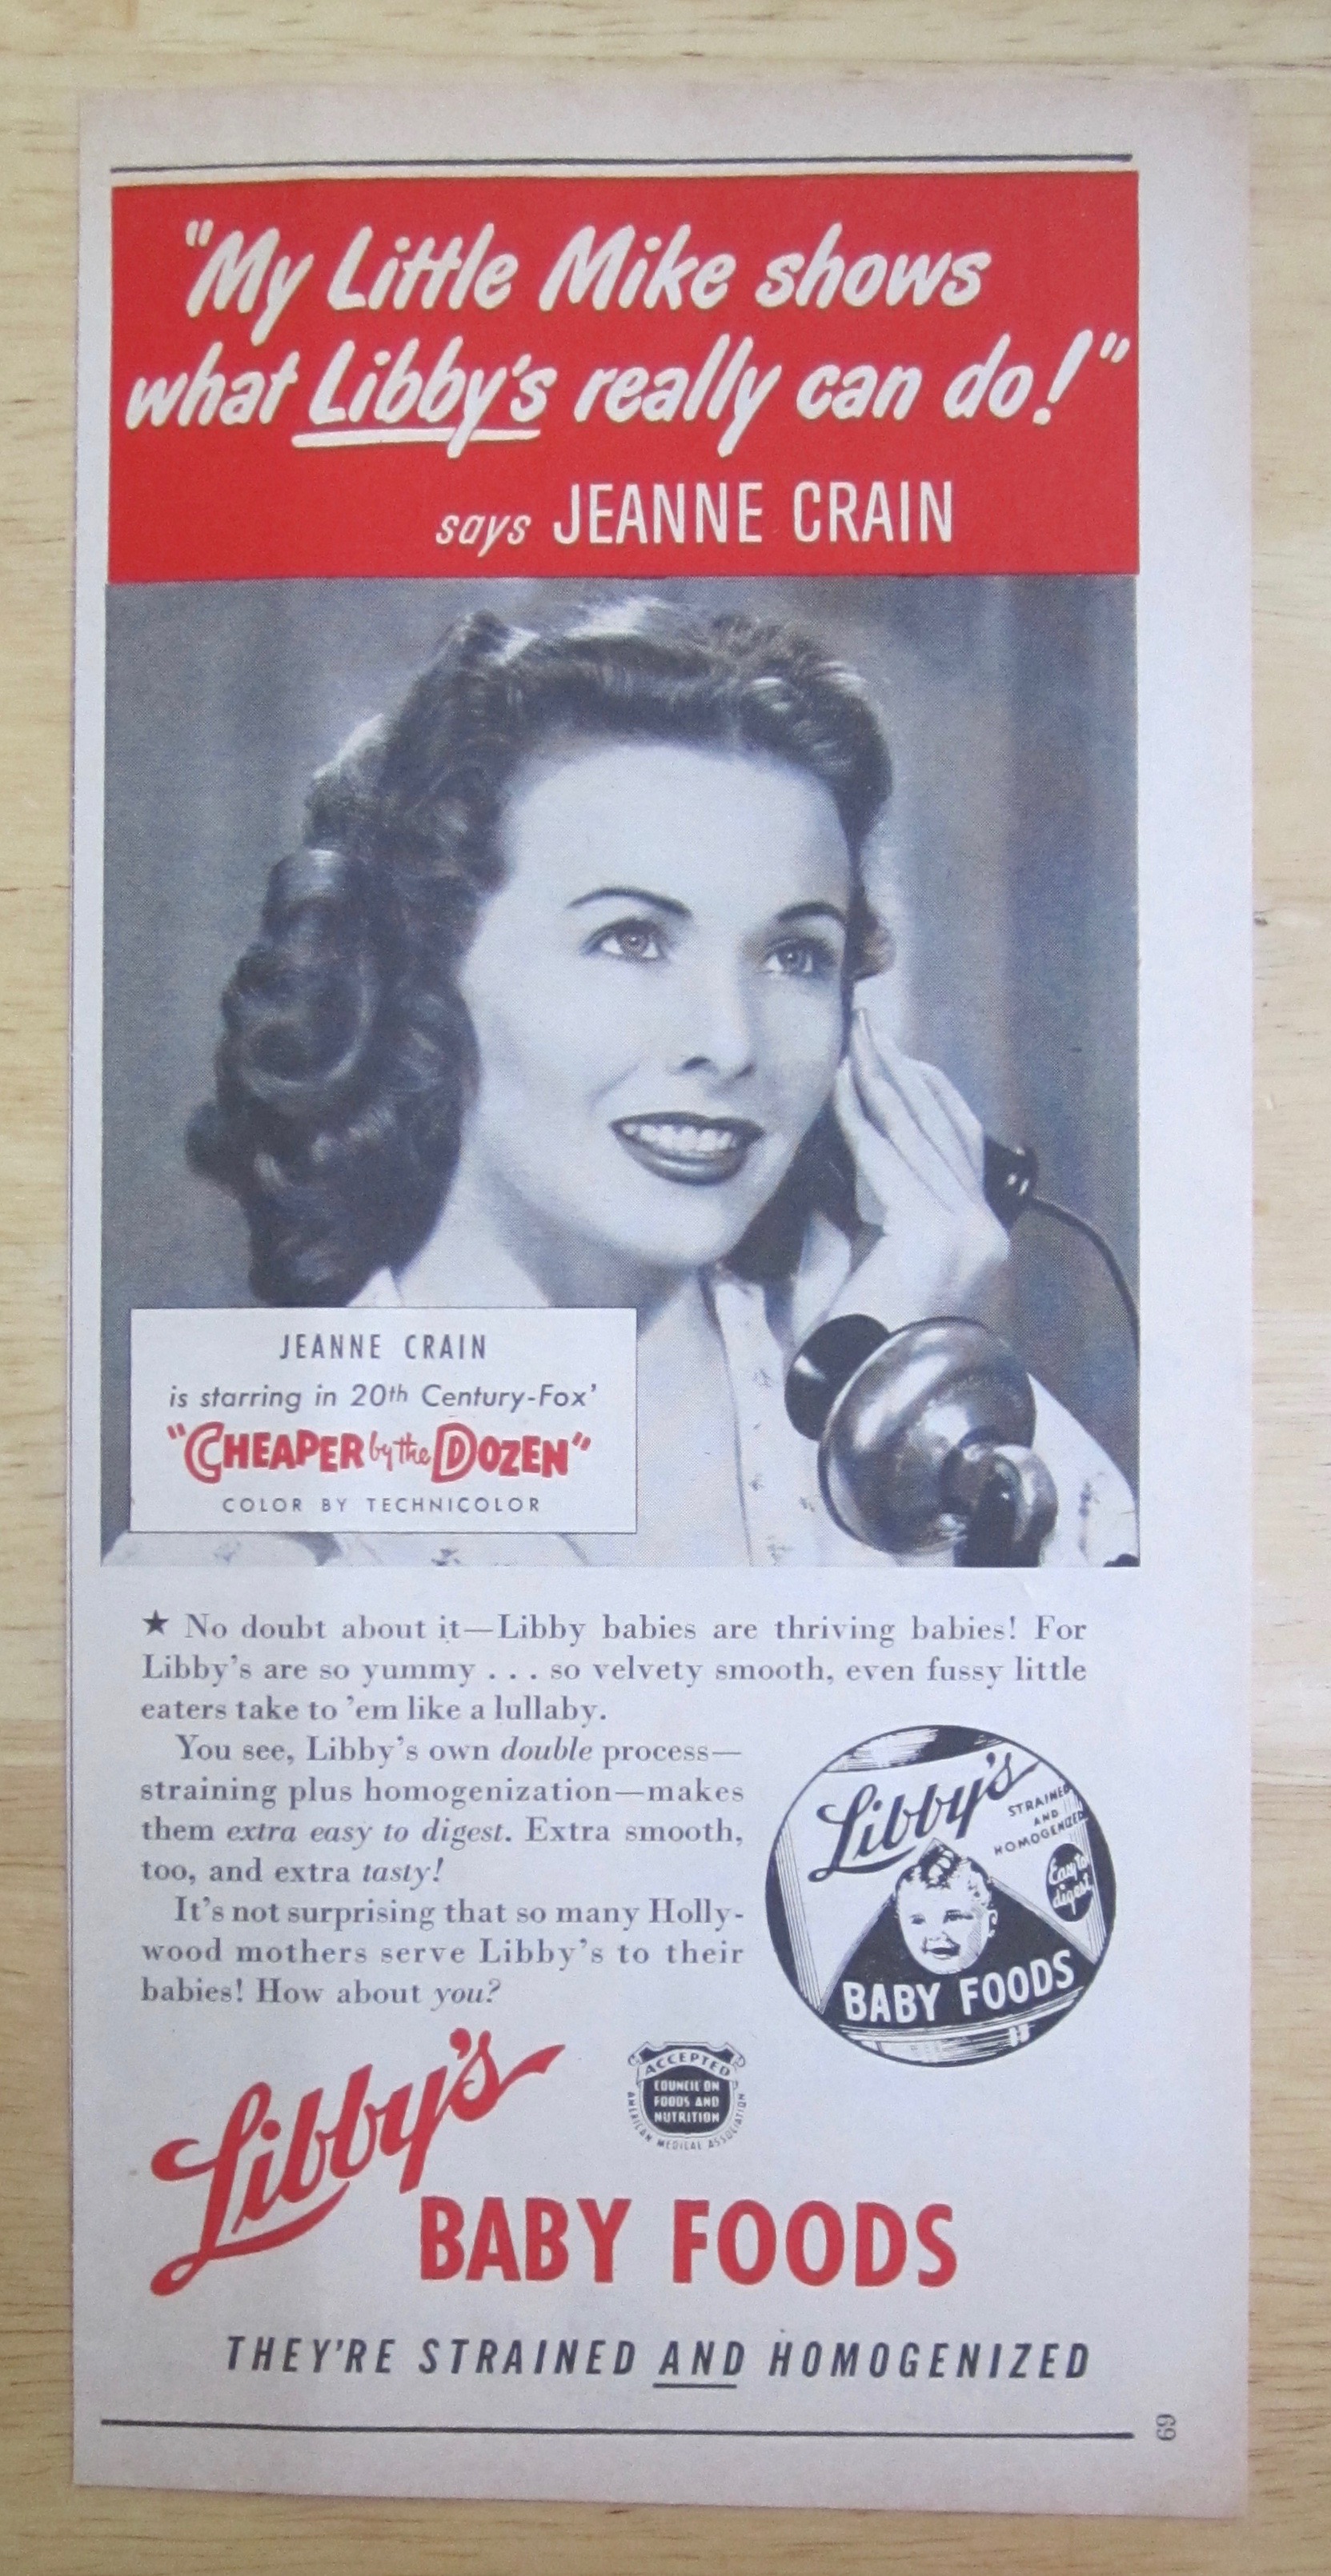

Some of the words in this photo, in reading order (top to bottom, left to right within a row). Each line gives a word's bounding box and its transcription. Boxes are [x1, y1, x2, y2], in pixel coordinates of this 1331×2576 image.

[185, 218, 315, 349] "My
[327, 222, 516, 311] Little
[538, 223, 737, 312] Mike
[754, 222, 992, 310] shows
[125, 337, 300, 431] what
[313, 335, 558, 459] Libby's
[573, 333, 783, 459] really
[796, 363, 923, 421] can
[942, 328, 1131, 426] do!"
[435, 514, 532, 558] says
[553, 482, 763, 545] JEANNE
[793, 480, 952, 543] CRAIN
[279, 1333, 381, 1360] JEANNE
[404, 1333, 486, 1360] CRAIN
[169, 1384, 188, 1408] is
[199, 1384, 302, 1414] starring
[315, 1383, 338, 1407] in
[350, 1383, 408, 1408] 20th
[421, 1383, 597, 1414] Century-Fox'
[368, 1430, 394, 1473] by
[394, 1433, 431, 1470] the
[431, 1422, 591, 1484] DOZEN"
[222, 1497, 302, 1514] COLOR
[321, 1497, 347, 1512] BY
[366, 1496, 539, 1514] TECHNICOLOR
[186, 1613, 227, 1638] No
[241, 1613, 325, 1640] doubt
[342, 1614, 425, 1639] about
[603, 1613, 696, 1640] babies
[713, 1624, 758, 1640] are
[774, 1614, 896, 1649] thriving
[912, 1615, 1016, 1640] babies!
[1035, 1615, 1087, 1641] For
[142, 1653, 252, 1688] Libby's
[263, 1664, 307, 1680] are
[319, 1665, 350, 1680] so
[362, 1664, 475, 1689] yummy
[551, 1664, 581, 1680] so
[592, 1654, 703, 1689] velvety
[716, 1655, 834, 1684] smooth,
[846, 1665, 914, 1681] even
[927, 1655, 1003, 1690] fussy
[1016, 1655, 1086, 1681] little
[140, 1700, 227, 1720] eaters
[235, 1694, 299, 1721] take
[308, 1701, 338, 1721] to
[347, 1694, 398, 1721] 'em
[408, 1695, 460, 1721] like
[470, 1705, 485, 1721] a
[495, 1694, 607, 1729] lullaby.
[175, 1733, 231, 1761] You
[243, 1745, 295, 1765] see,
[306, 1735, 419, 1769] Libby's
[429, 1745, 489, 1761] own
[500, 1735, 593, 1761] double
[140, 1776, 278, 1810] straining
[288, 1776, 352, 1811] plus
[1008, 1783, 1072, 1817] STRAINED
[141, 1815, 214, 1841] them
[226, 1823, 296, 1843] extra
[310, 1826, 373, 1851] easy
[383, 1823, 409, 1843] to
[421, 1817, 512, 1851] digest.
[525, 1816, 610, 1842] Extra
[625, 1817, 743, 1845] smooth,
[807, 1752, 1041, 1883] Libby's
[994, 1810, 1086, 1855] HOMOGENIZED
[1034, 1809, 1059, 1826] AND
[141, 1861, 196, 1885] too,
[209, 1857, 263, 1882] and
[274, 1863, 351, 1883] extra
[362, 1857, 444, 1892] tasty!
[1048, 1857, 1078, 1885] Easy
[1074, 1853, 1089, 1870] to
[174, 1896, 224, 1922] It's
[232, 1903, 280, 1923] not
[287, 1898, 435, 1932] surprising
[444, 1897, 507, 1924] that
[516, 1907, 547, 1924] so
[556, 1907, 639, 1932] many
[649, 1897, 744, 1933] Holly-
[141, 1937, 222, 1962] wood
[236, 1937, 367, 1964] mothers
[381, 1947, 465, 1964] serve
[479, 1937, 603, 1972] Libby's
[617, 1944, 650, 1965] to
[666, 1939, 744, 1964] their
[141, 1976, 243, 2003] babies!
[256, 1977, 323, 2004] How
[336, 1979, 419, 2004] about
[430, 1979, 502, 2012] you?
[842, 1981, 941, 2024] BABY
[960, 1949, 1075, 2016] FOODS
[646, 2052, 730, 2076] ACCEPTED
[654, 2080, 700, 2091] COUNCIL
[704, 2081, 720, 2091] ON
[654, 2096, 690, 2107] FOODS
[695, 2096, 719, 2107] AND
[627, 2091, 652, 2142] AMERICAN
[657, 2138, 701, 2150] MEDICAL
[708, 2093, 746, 2149] ASSOCIATION
[654, 2111, 720, 2122] NUTRITION
[148, 2025, 566, 2300] Libby's
[420, 2196, 631, 2283] BABY
[672, 2199, 957, 2289] FOODS
[227, 2335, 395, 2374] THEY'RE
[418, 2338, 635, 2375] STRAINED
[658, 2340, 745, 2376] AND
[768, 2341, 1089, 2379] HOMOGENIZED
